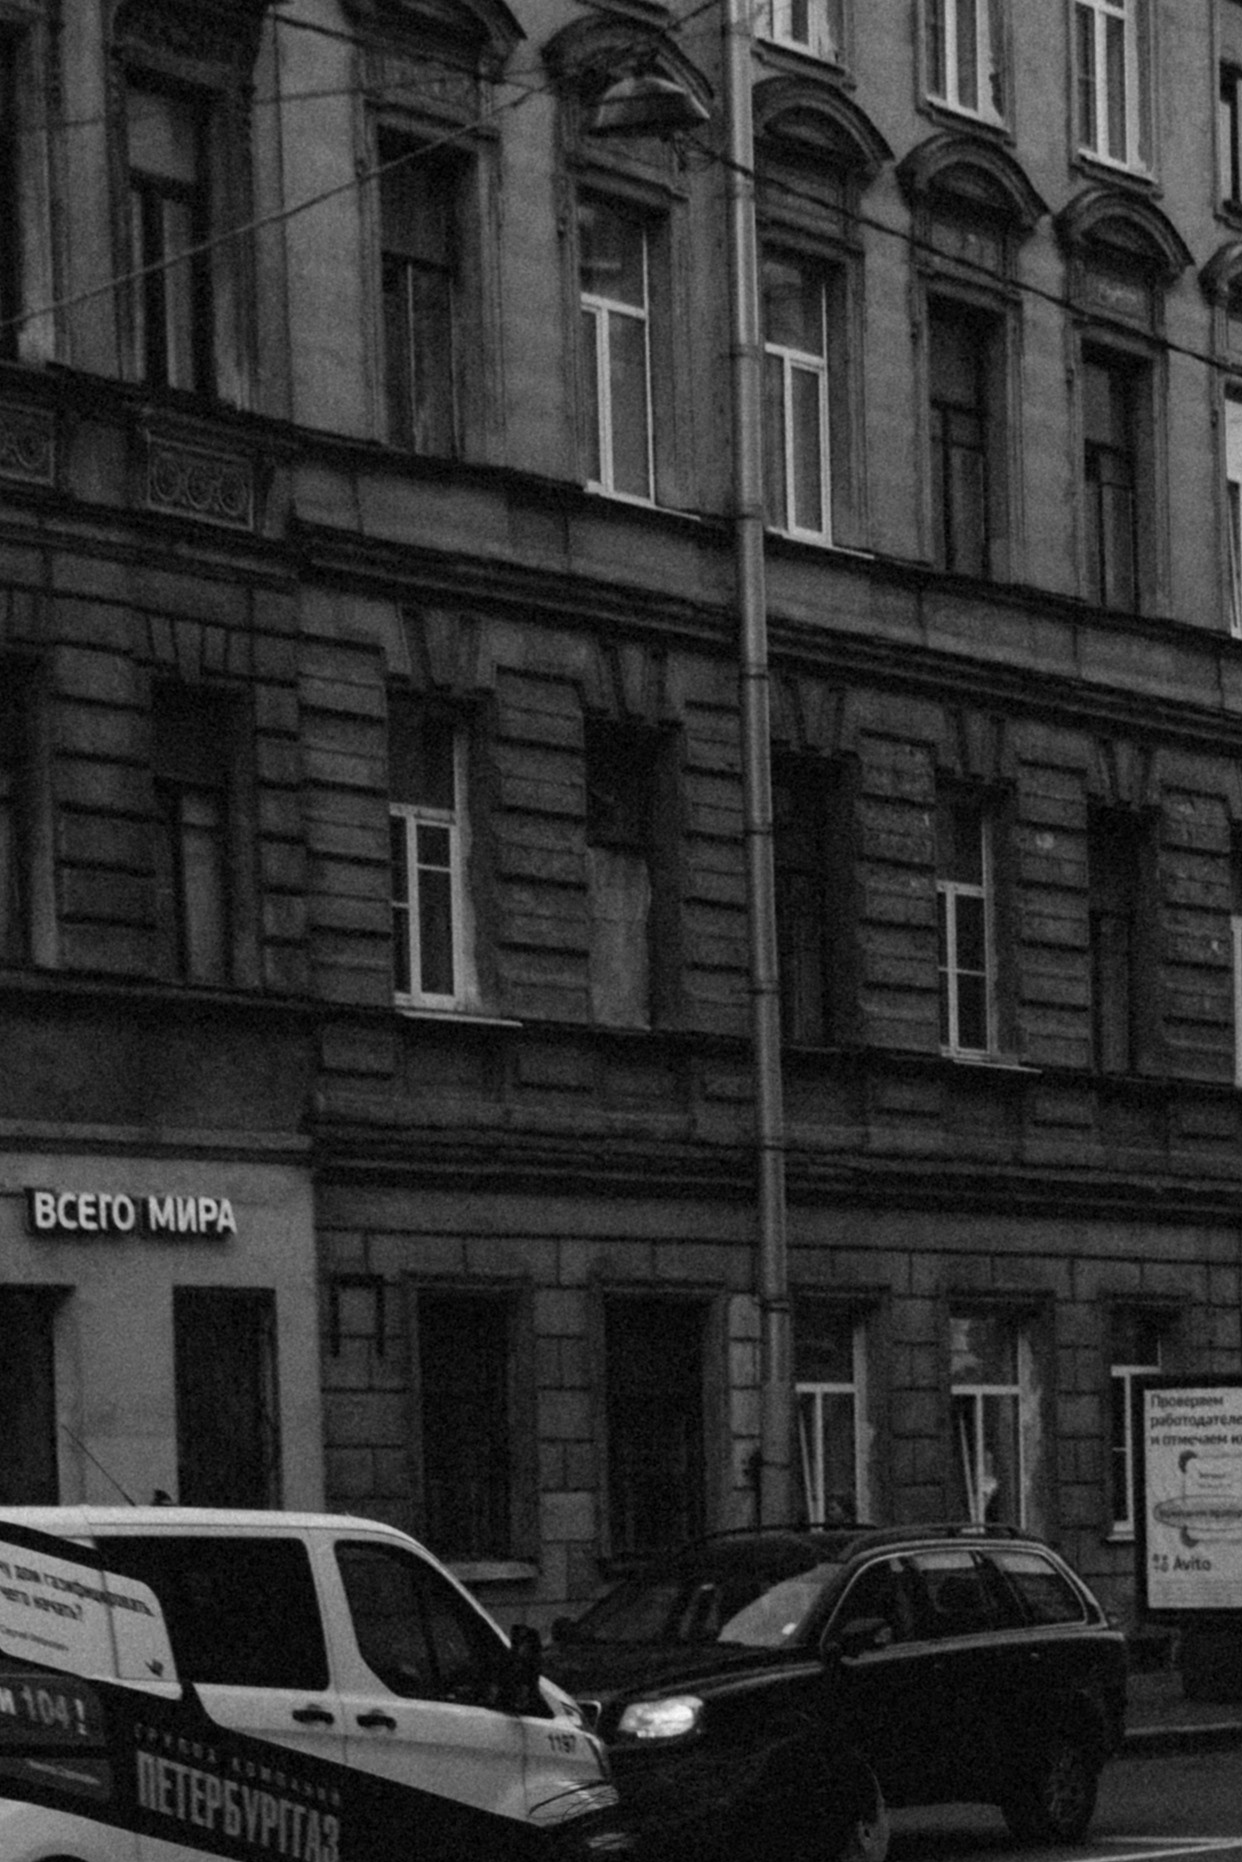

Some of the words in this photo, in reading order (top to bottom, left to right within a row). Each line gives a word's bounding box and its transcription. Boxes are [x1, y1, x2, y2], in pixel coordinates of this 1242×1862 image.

[34, 1192, 136, 1231] ВСЕГО
[148, 1195, 238, 1233] МИРА
[1173, 1555, 1212, 1572] Avito
